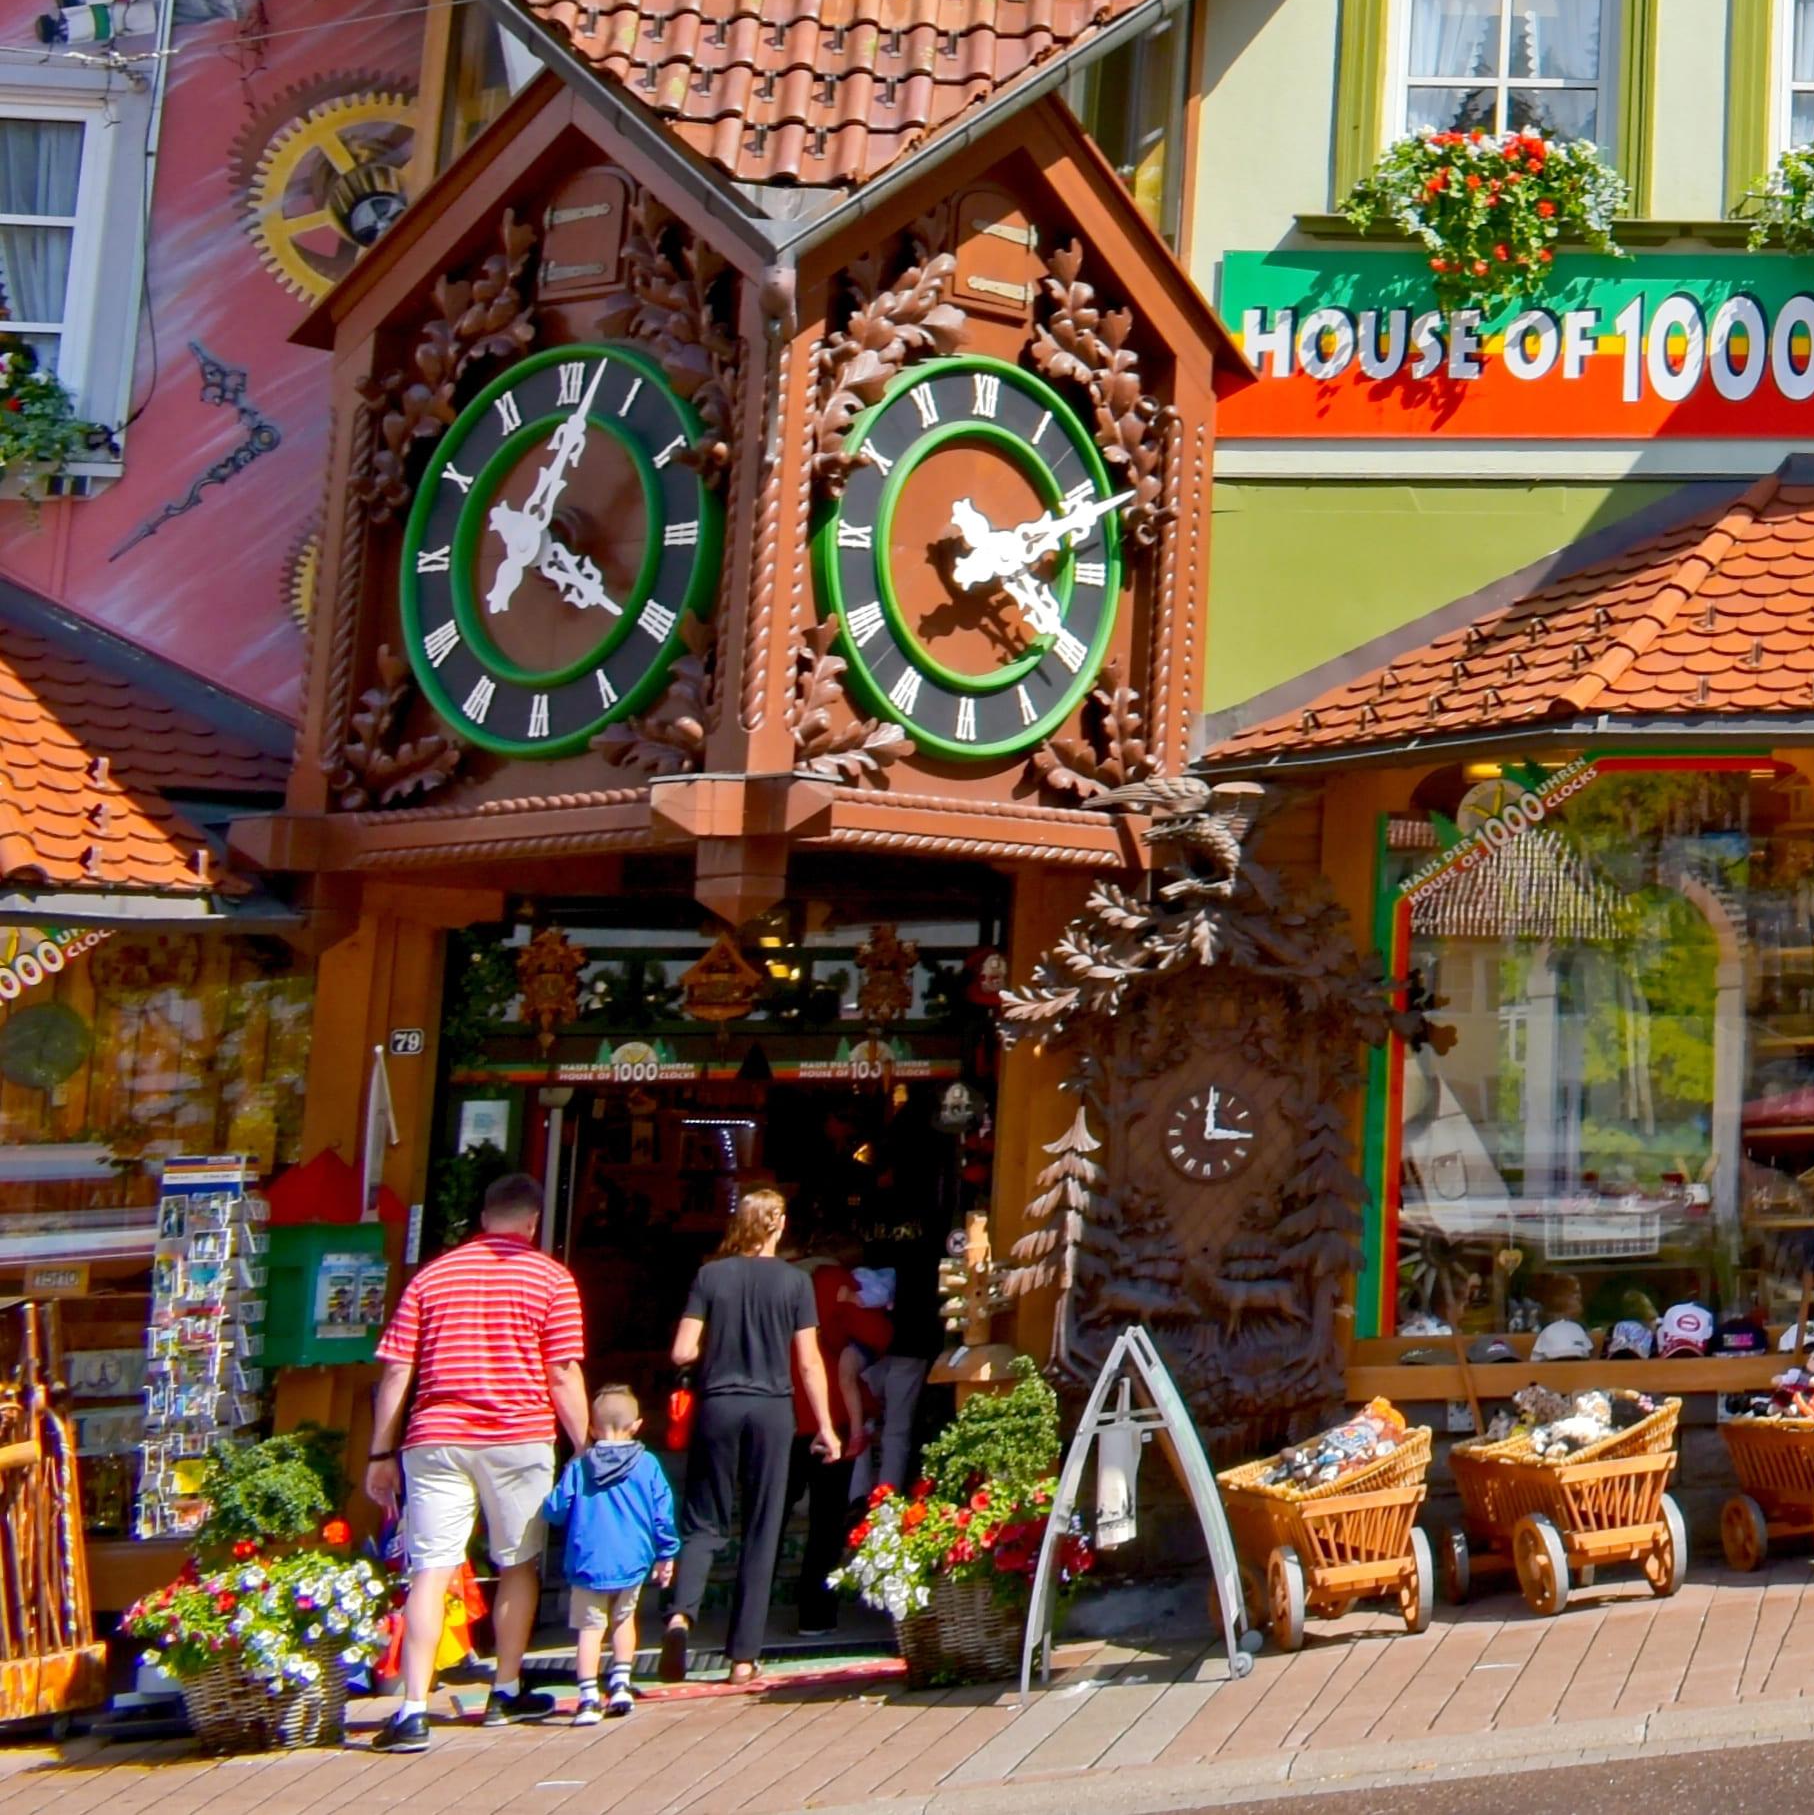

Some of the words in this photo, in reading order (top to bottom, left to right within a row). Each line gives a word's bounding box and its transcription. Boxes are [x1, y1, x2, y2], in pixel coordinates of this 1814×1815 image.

[1243, 308, 1482, 380] HOUSE
[1504, 309, 1598, 380] OF
[1399, 859, 1441, 892] HAUS
[1442, 838, 1473, 863] DER
[1474, 791, 1545, 854] 1000
[1535, 756, 1587, 795] UHREN
[1408, 866, 1459, 905] HOUSE
[1461, 849, 1483, 867] OF
[1546, 767, 1598, 808] CLOCKS
[0, 941, 65, 999] 000
[394, 1030, 421, 1052] 79
[851, 1060, 882, 1078] 100
[613, 1063, 658, 1081] 1000
